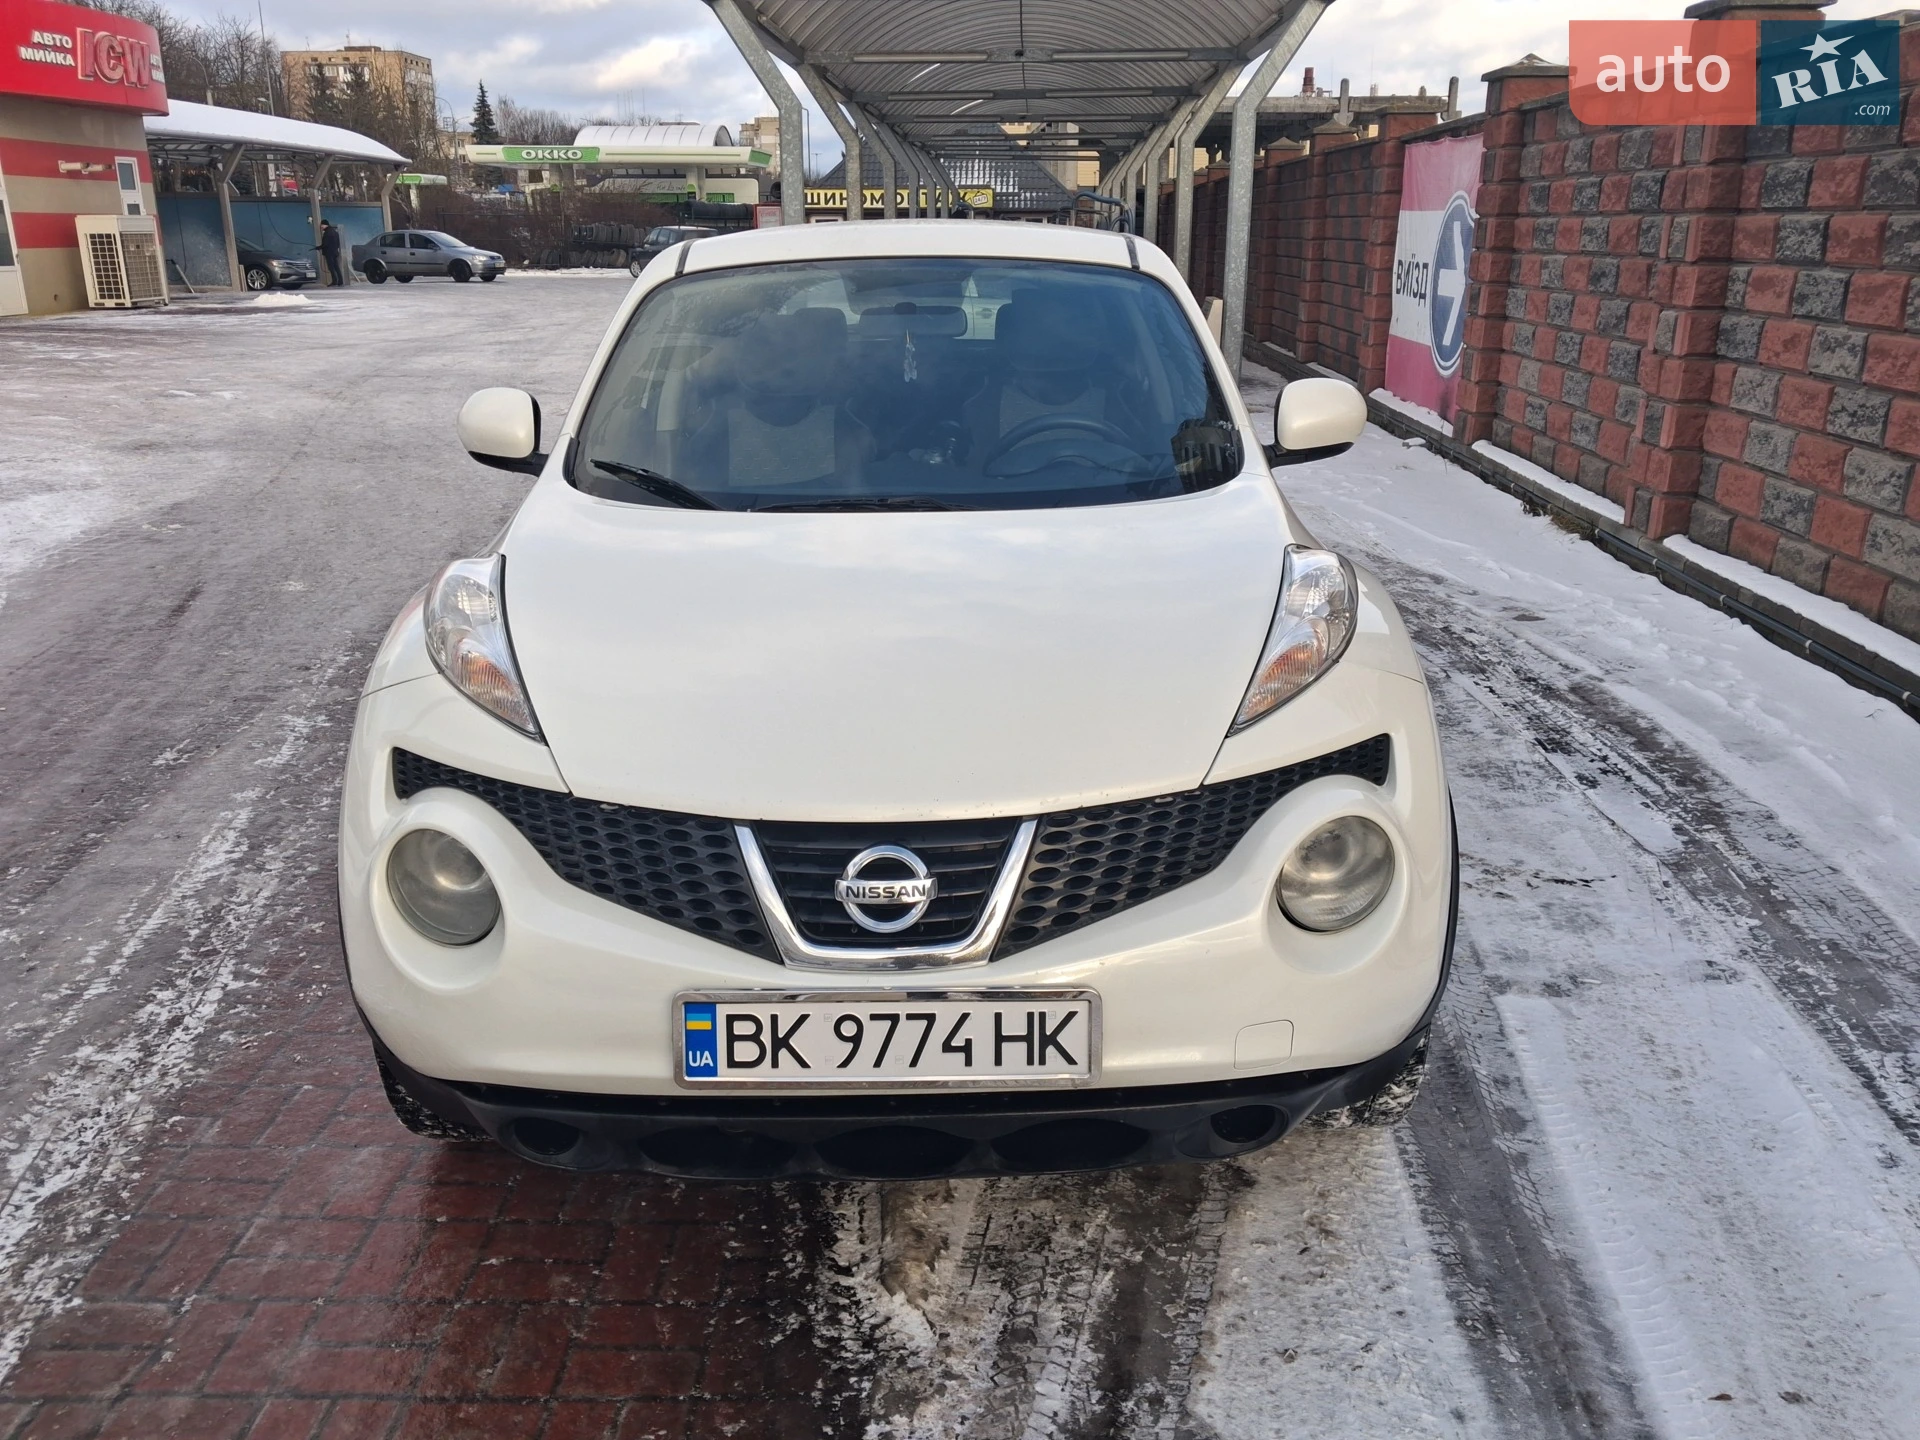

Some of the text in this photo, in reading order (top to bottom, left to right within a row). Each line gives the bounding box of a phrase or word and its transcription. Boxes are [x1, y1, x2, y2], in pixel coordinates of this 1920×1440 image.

[33, 31, 73, 49] АВТО
[19, 46, 75, 67] МИЙКА
[77, 28, 150, 88] ICW
[521, 149, 583, 160] OKKO
[1396, 253, 1429, 308] ВИЇЗД
[845, 883, 927, 899] NISSAN
[725, 1010, 1079, 1069] BK 9774 HK
[688, 1051, 714, 1067] UA
